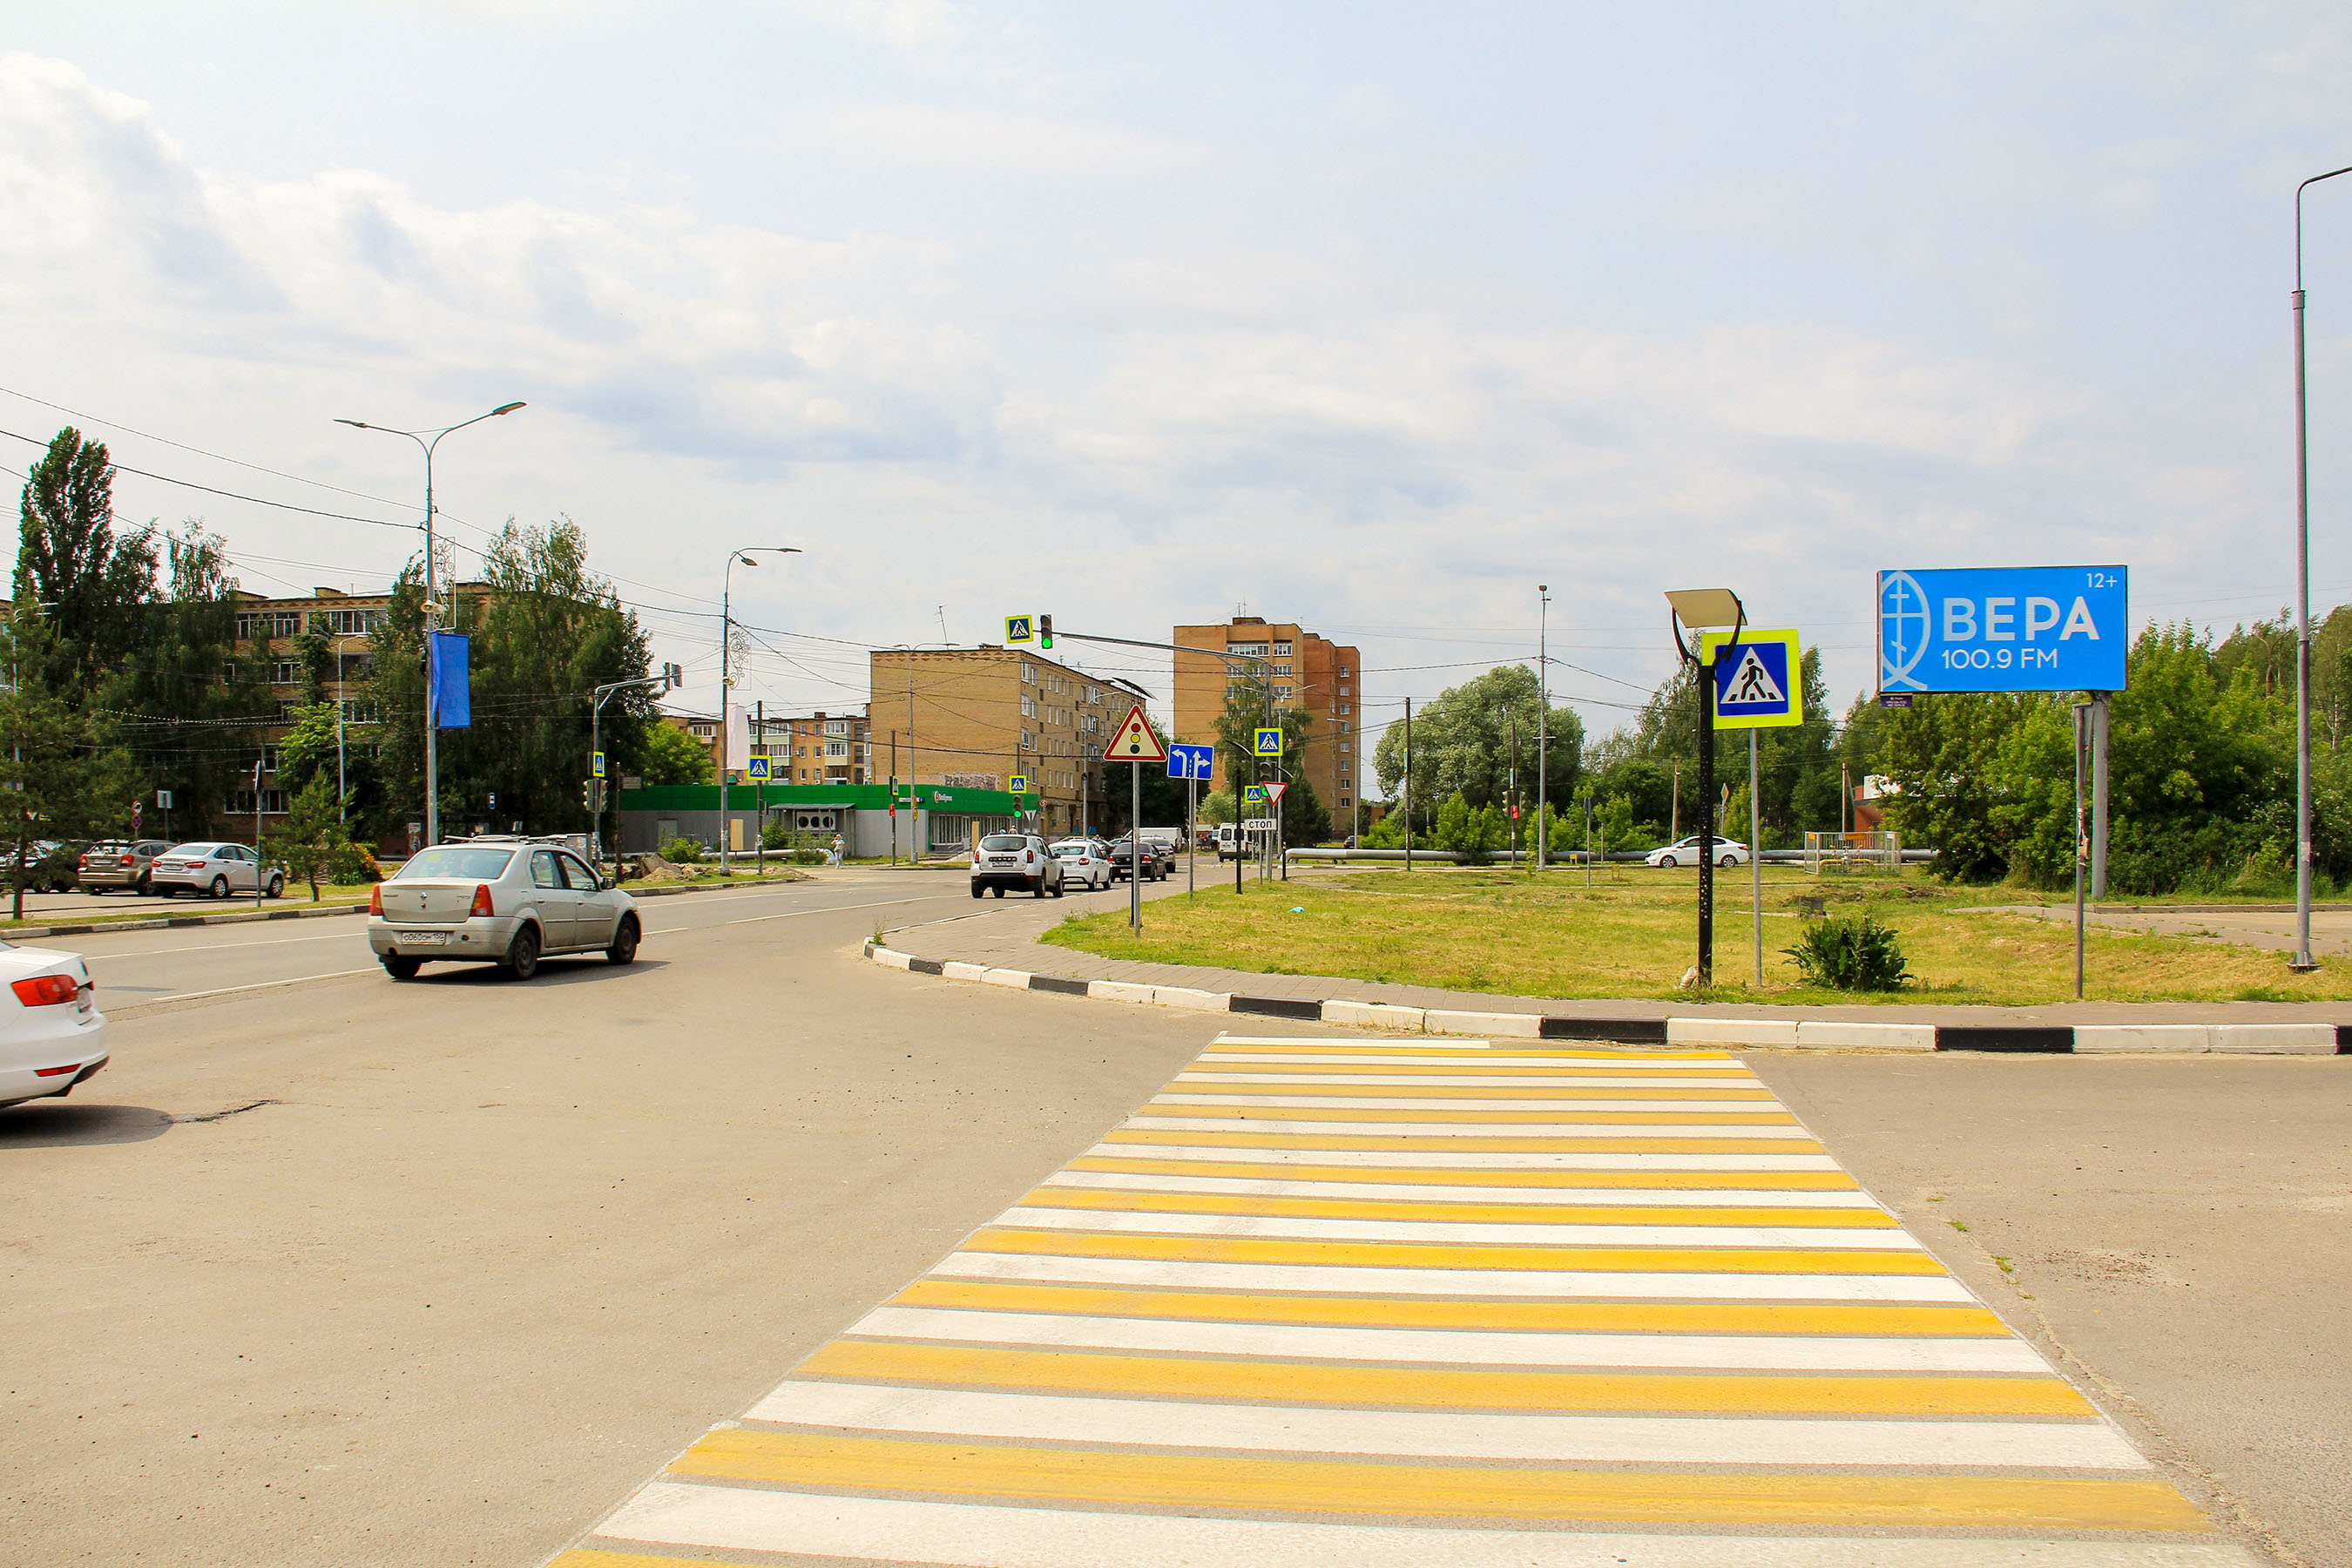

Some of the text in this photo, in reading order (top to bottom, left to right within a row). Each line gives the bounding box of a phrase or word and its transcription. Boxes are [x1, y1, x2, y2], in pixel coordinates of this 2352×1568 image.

[2086, 573, 2118, 588] 12+
[1943, 596, 2100, 641] ВЕРА
[1942, 648, 2058, 669] 100.9 FM
